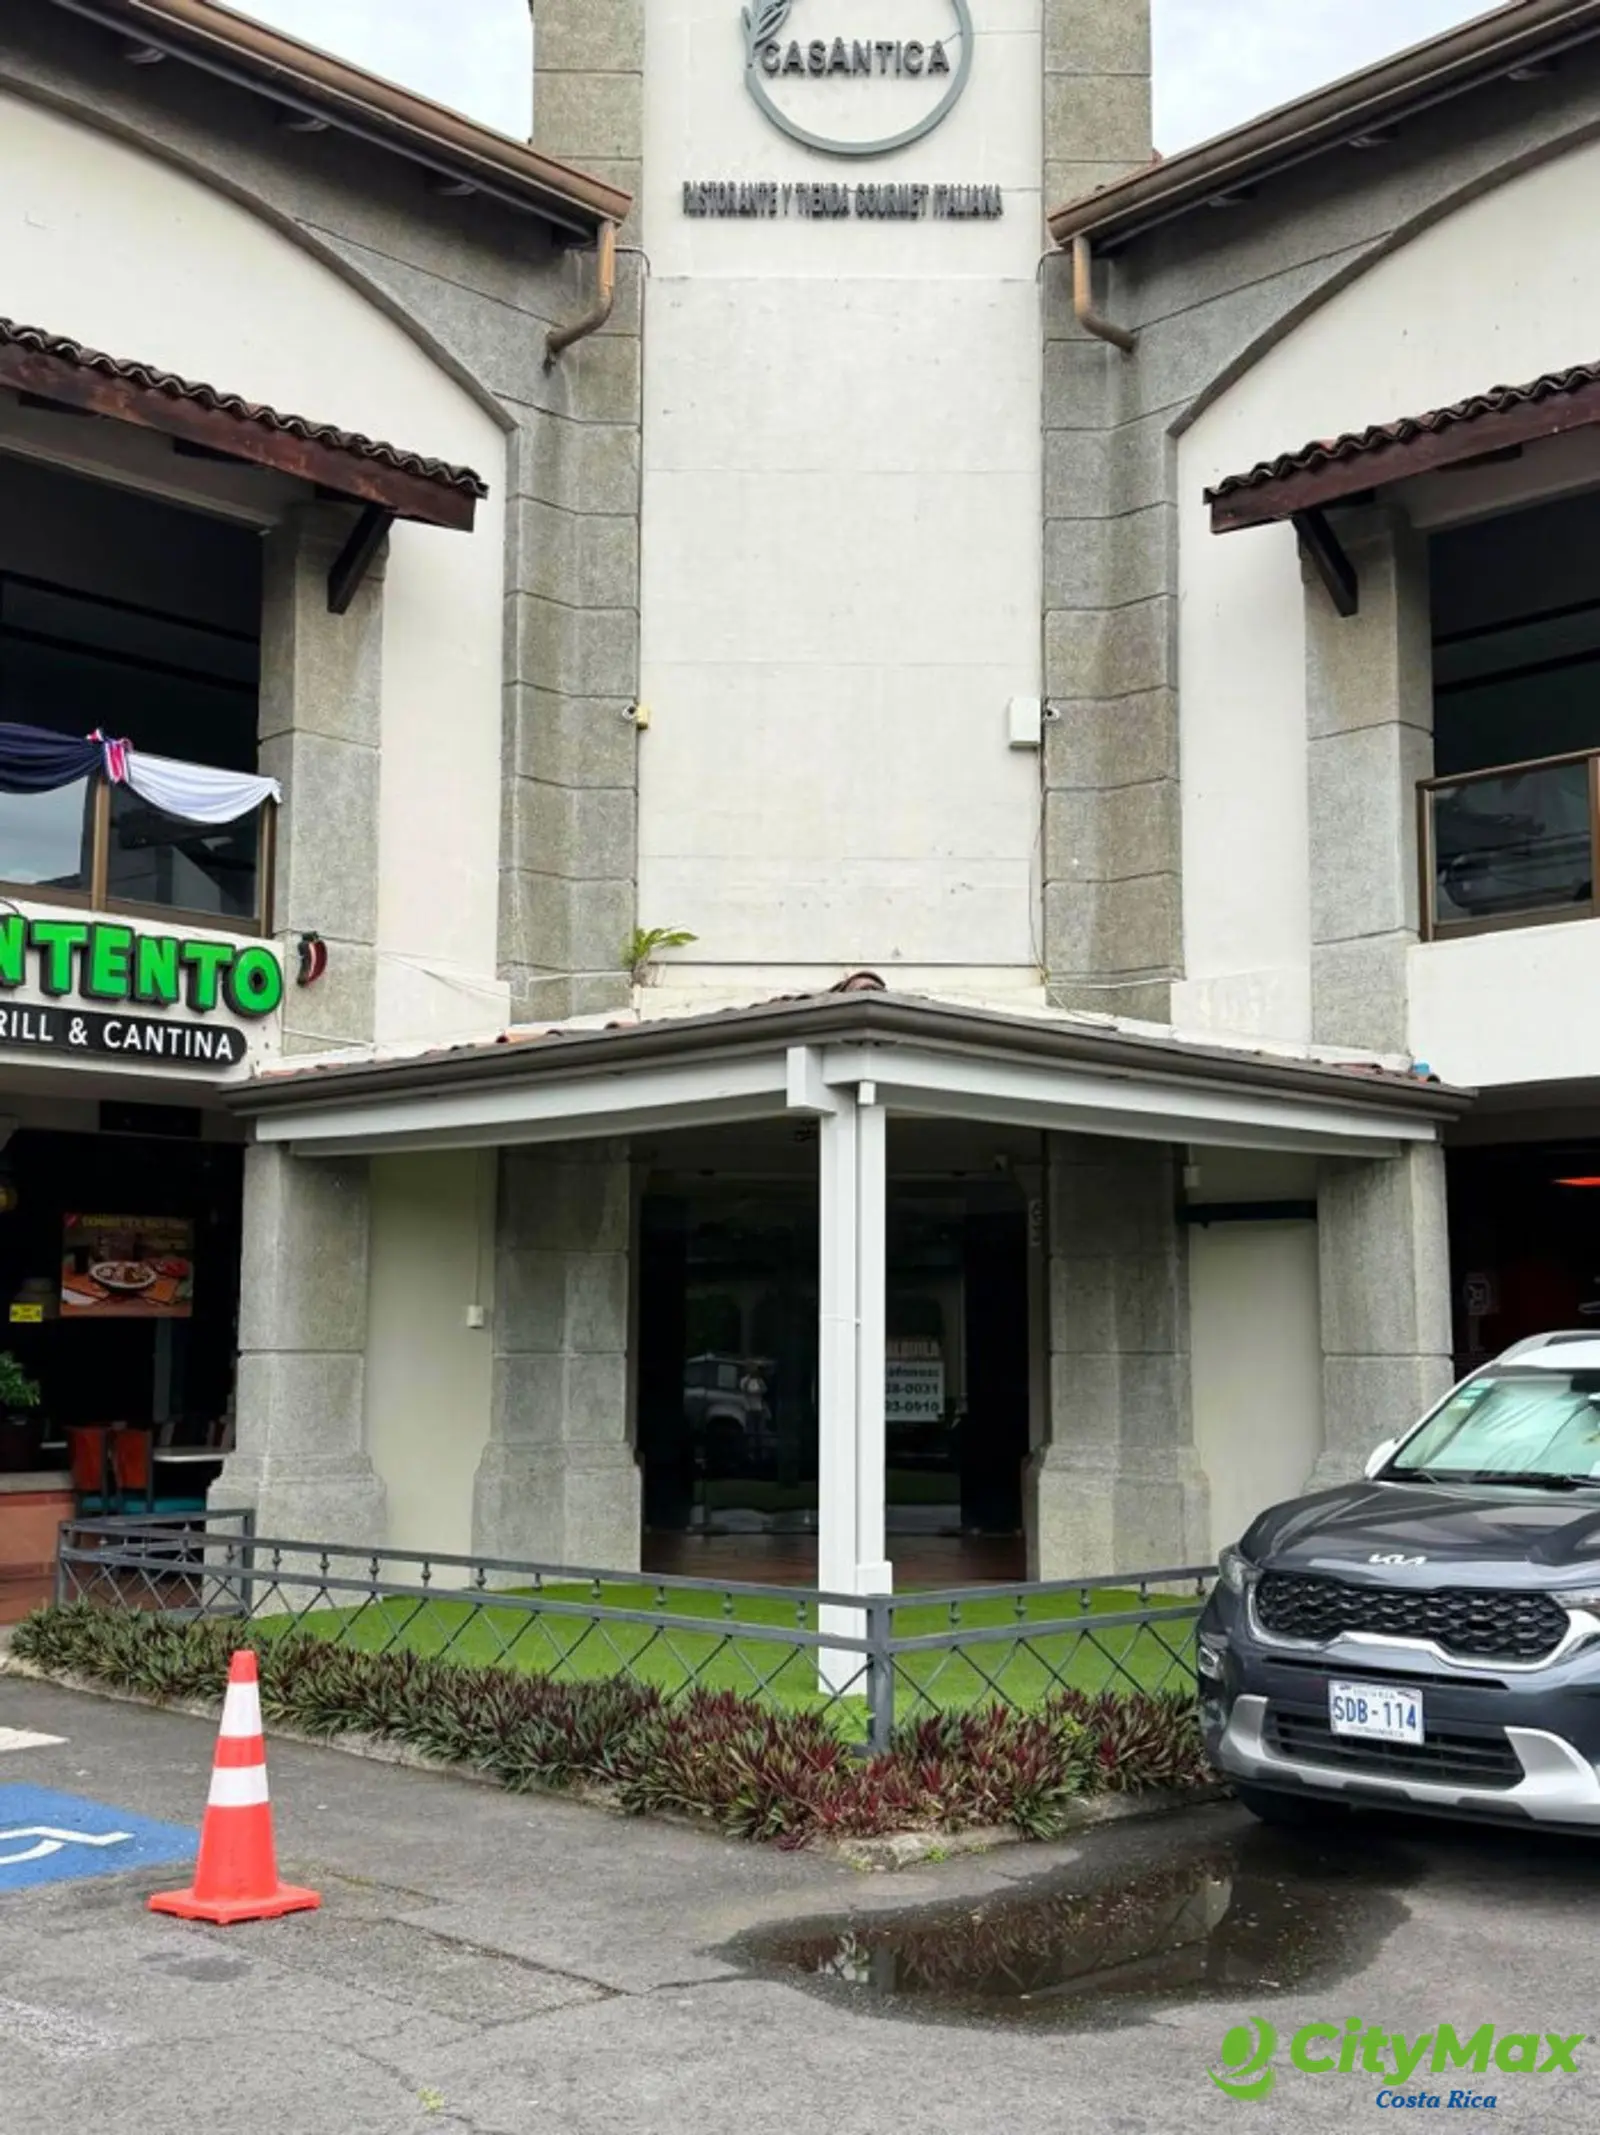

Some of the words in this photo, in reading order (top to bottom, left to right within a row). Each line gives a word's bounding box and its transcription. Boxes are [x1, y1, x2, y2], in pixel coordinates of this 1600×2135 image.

[782, 183, 792, 217] Y
[0, 914, 282, 1016] NTENTO
[68, 1017, 88, 1046] &
[103, 1021, 234, 1061] CANTINA
[1333, 1696, 1417, 1730] SDB-114
